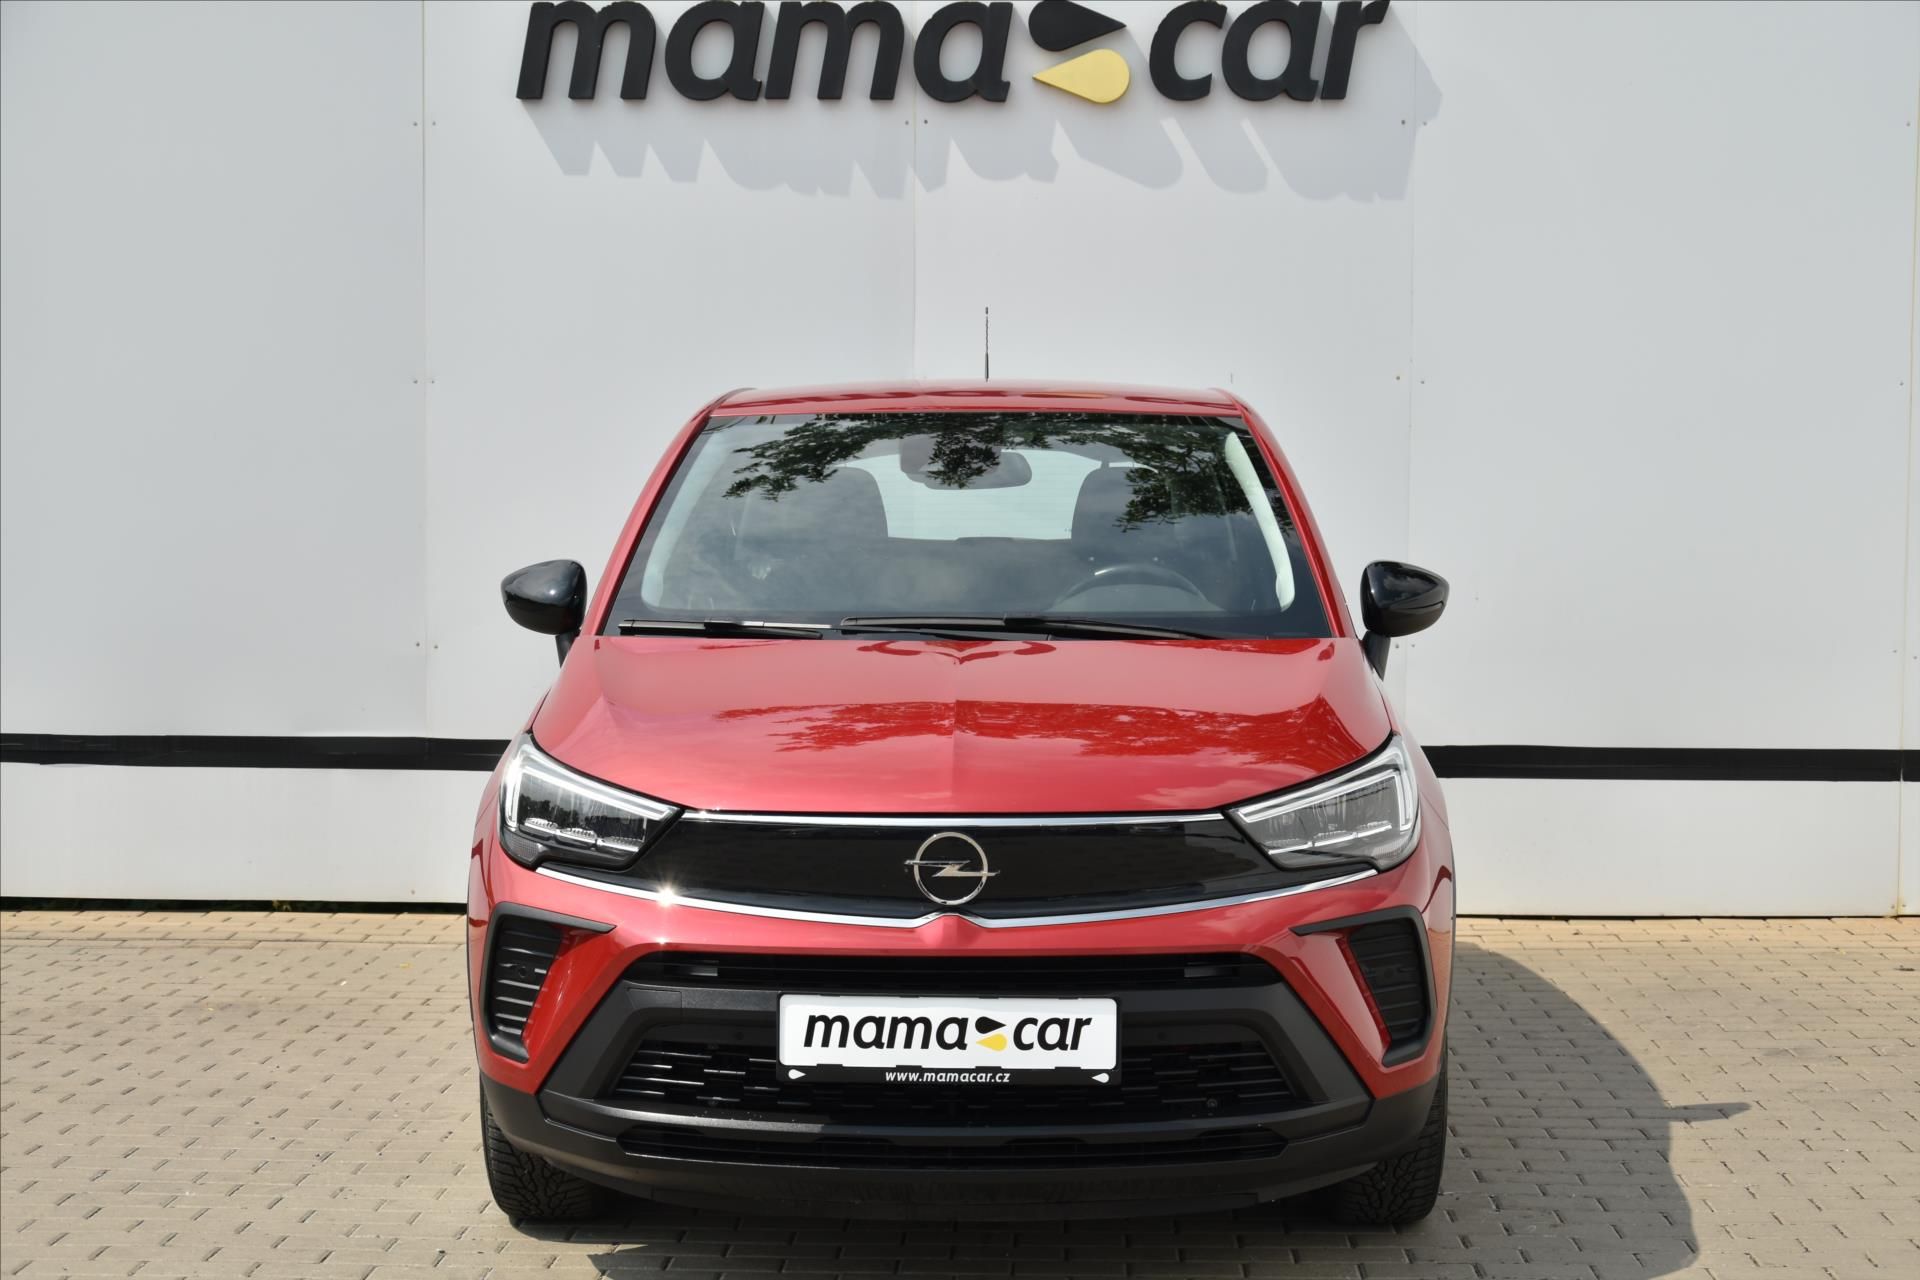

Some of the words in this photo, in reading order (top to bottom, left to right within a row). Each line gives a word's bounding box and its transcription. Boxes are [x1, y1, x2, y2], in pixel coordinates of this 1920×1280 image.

[516, 0, 1011, 102] mama
[1149, 0, 1390, 102] car
[804, 1014, 968, 1050] mama
[1013, 1017, 1092, 1051] car
[885, 1071, 1011, 1084] www.mamacar.cz
